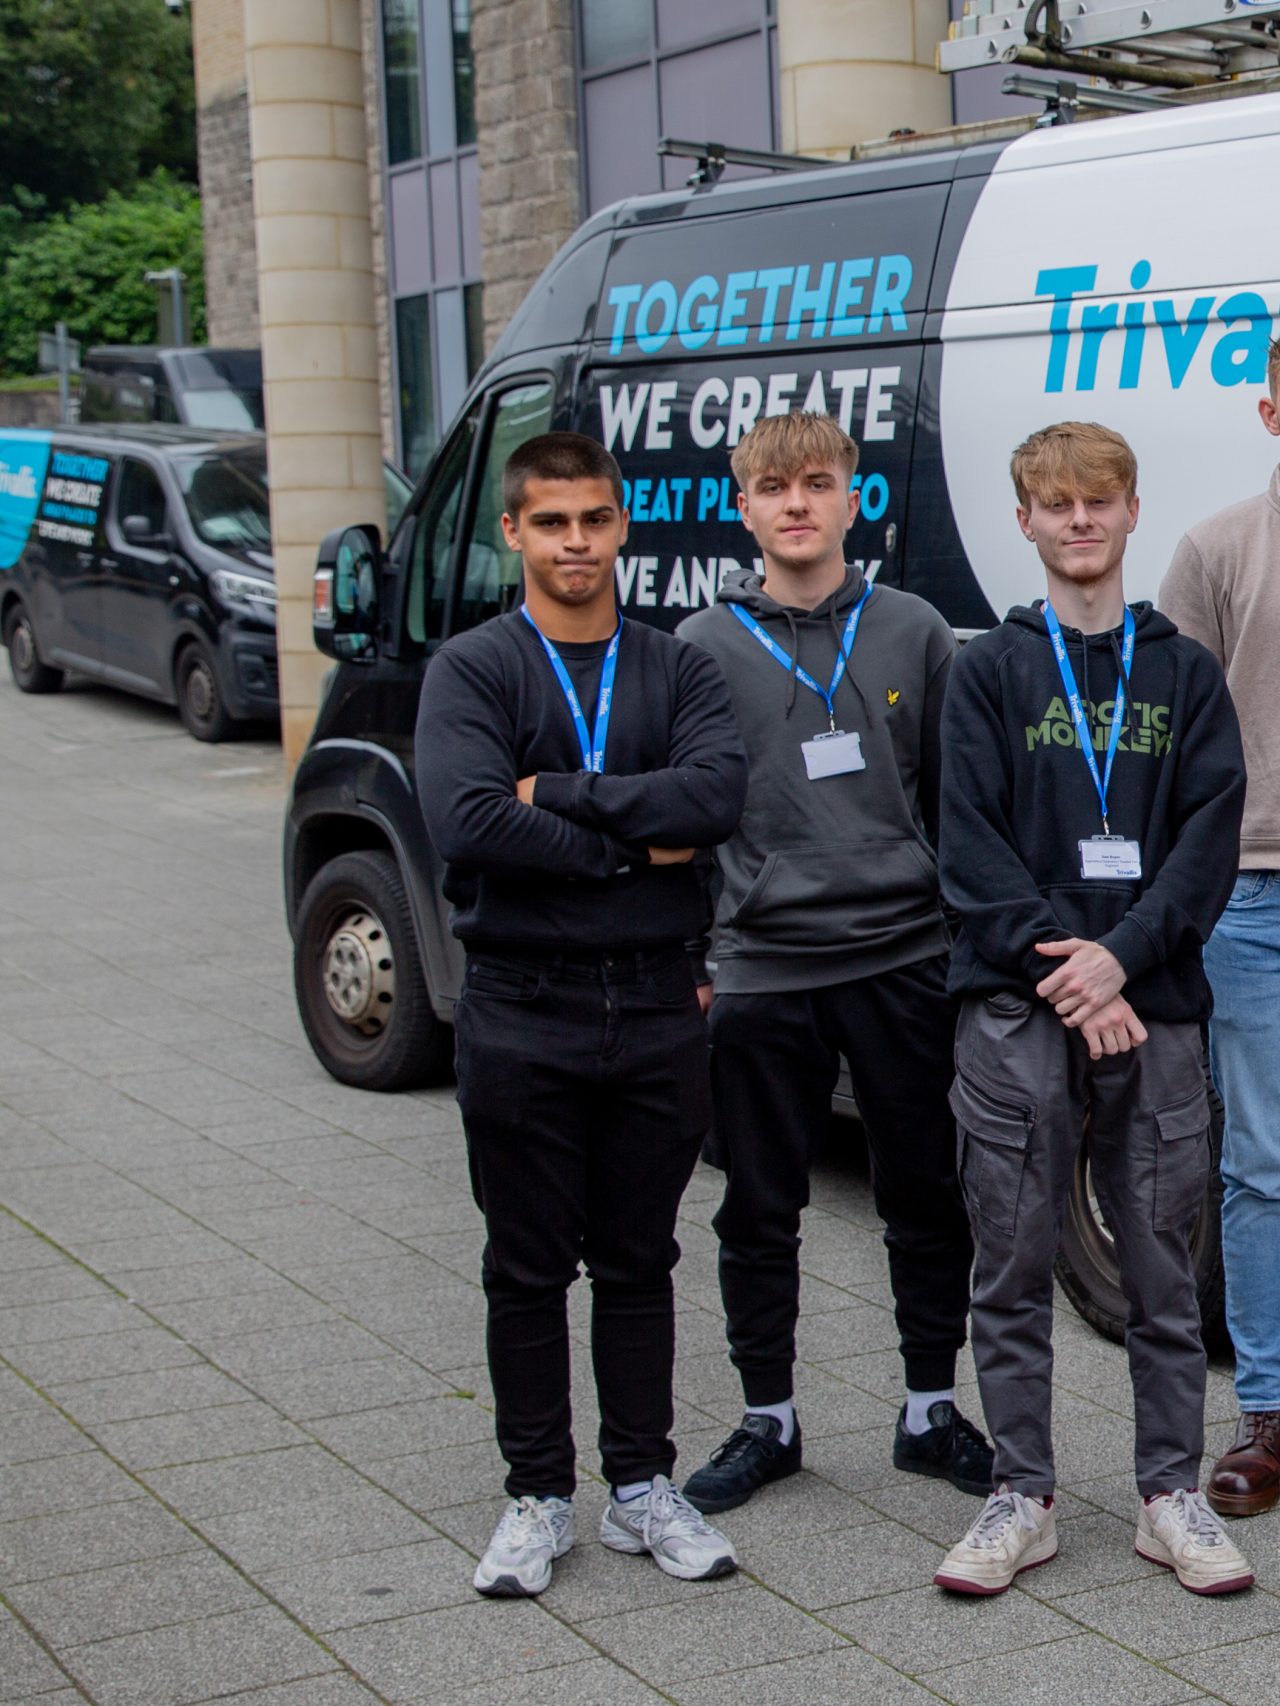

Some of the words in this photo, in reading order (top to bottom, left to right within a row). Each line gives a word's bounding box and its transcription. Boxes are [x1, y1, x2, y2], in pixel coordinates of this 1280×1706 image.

[607, 254, 914, 356] TOGETHER
[600, 380, 678, 452] WE
[689, 366, 901, 447] CREATE
[1050, 631, 1065, 663] Trivallis.
